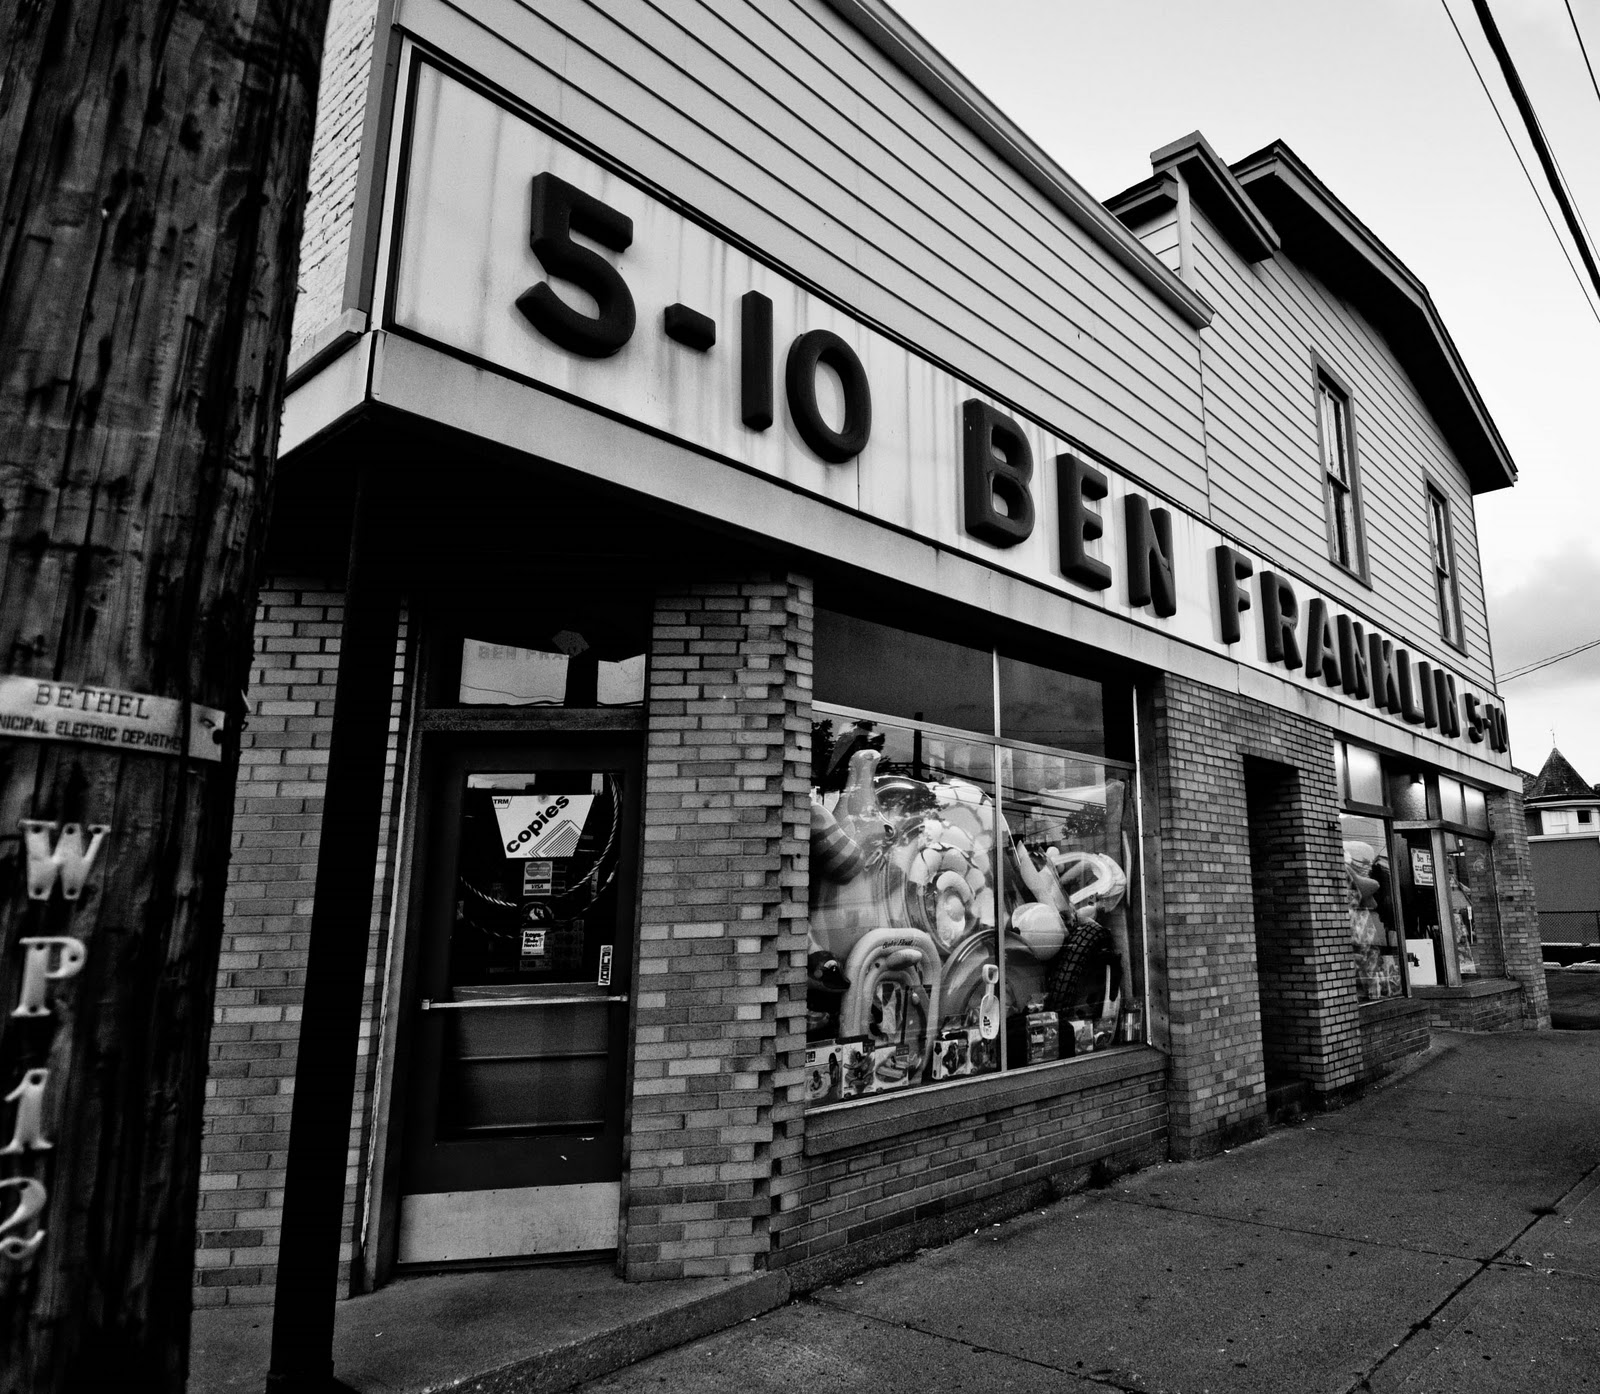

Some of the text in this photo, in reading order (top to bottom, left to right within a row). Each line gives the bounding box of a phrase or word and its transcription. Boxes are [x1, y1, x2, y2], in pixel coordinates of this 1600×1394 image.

[515, 171, 1508, 753] 5-10 BEN FRANKLIN 5-10
[34, 683, 150, 720] BETHEL
[55, 721, 117, 742] ELECTRIC
[506, 796, 570, 853] copies
